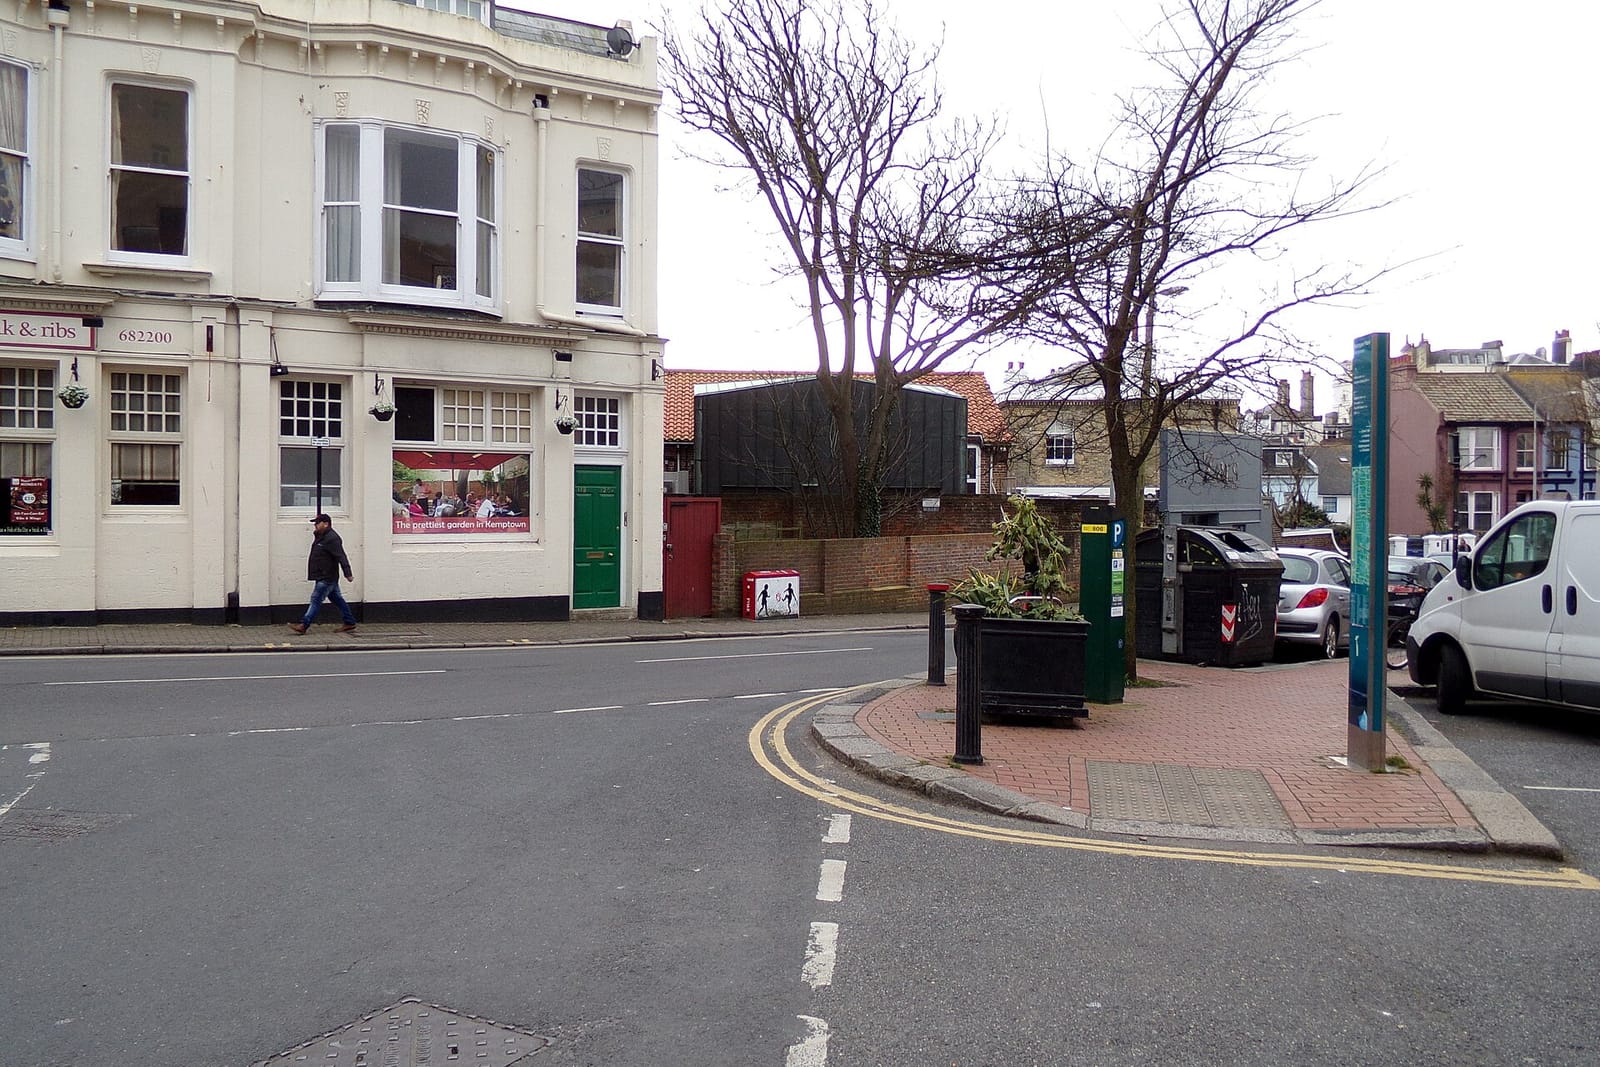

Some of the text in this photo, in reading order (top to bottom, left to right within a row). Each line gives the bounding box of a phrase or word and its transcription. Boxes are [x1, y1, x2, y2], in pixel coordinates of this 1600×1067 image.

[19, 321, 37, 337] &
[41, 322, 76, 339] ribs
[119, 329, 172, 343] 682200
[395, 521, 411, 529] The
[412, 521, 445, 529] prettiest
[446, 521, 475, 530] garden
[485, 520, 526, 530] Kemptown
[1114, 523, 1121, 543] P
